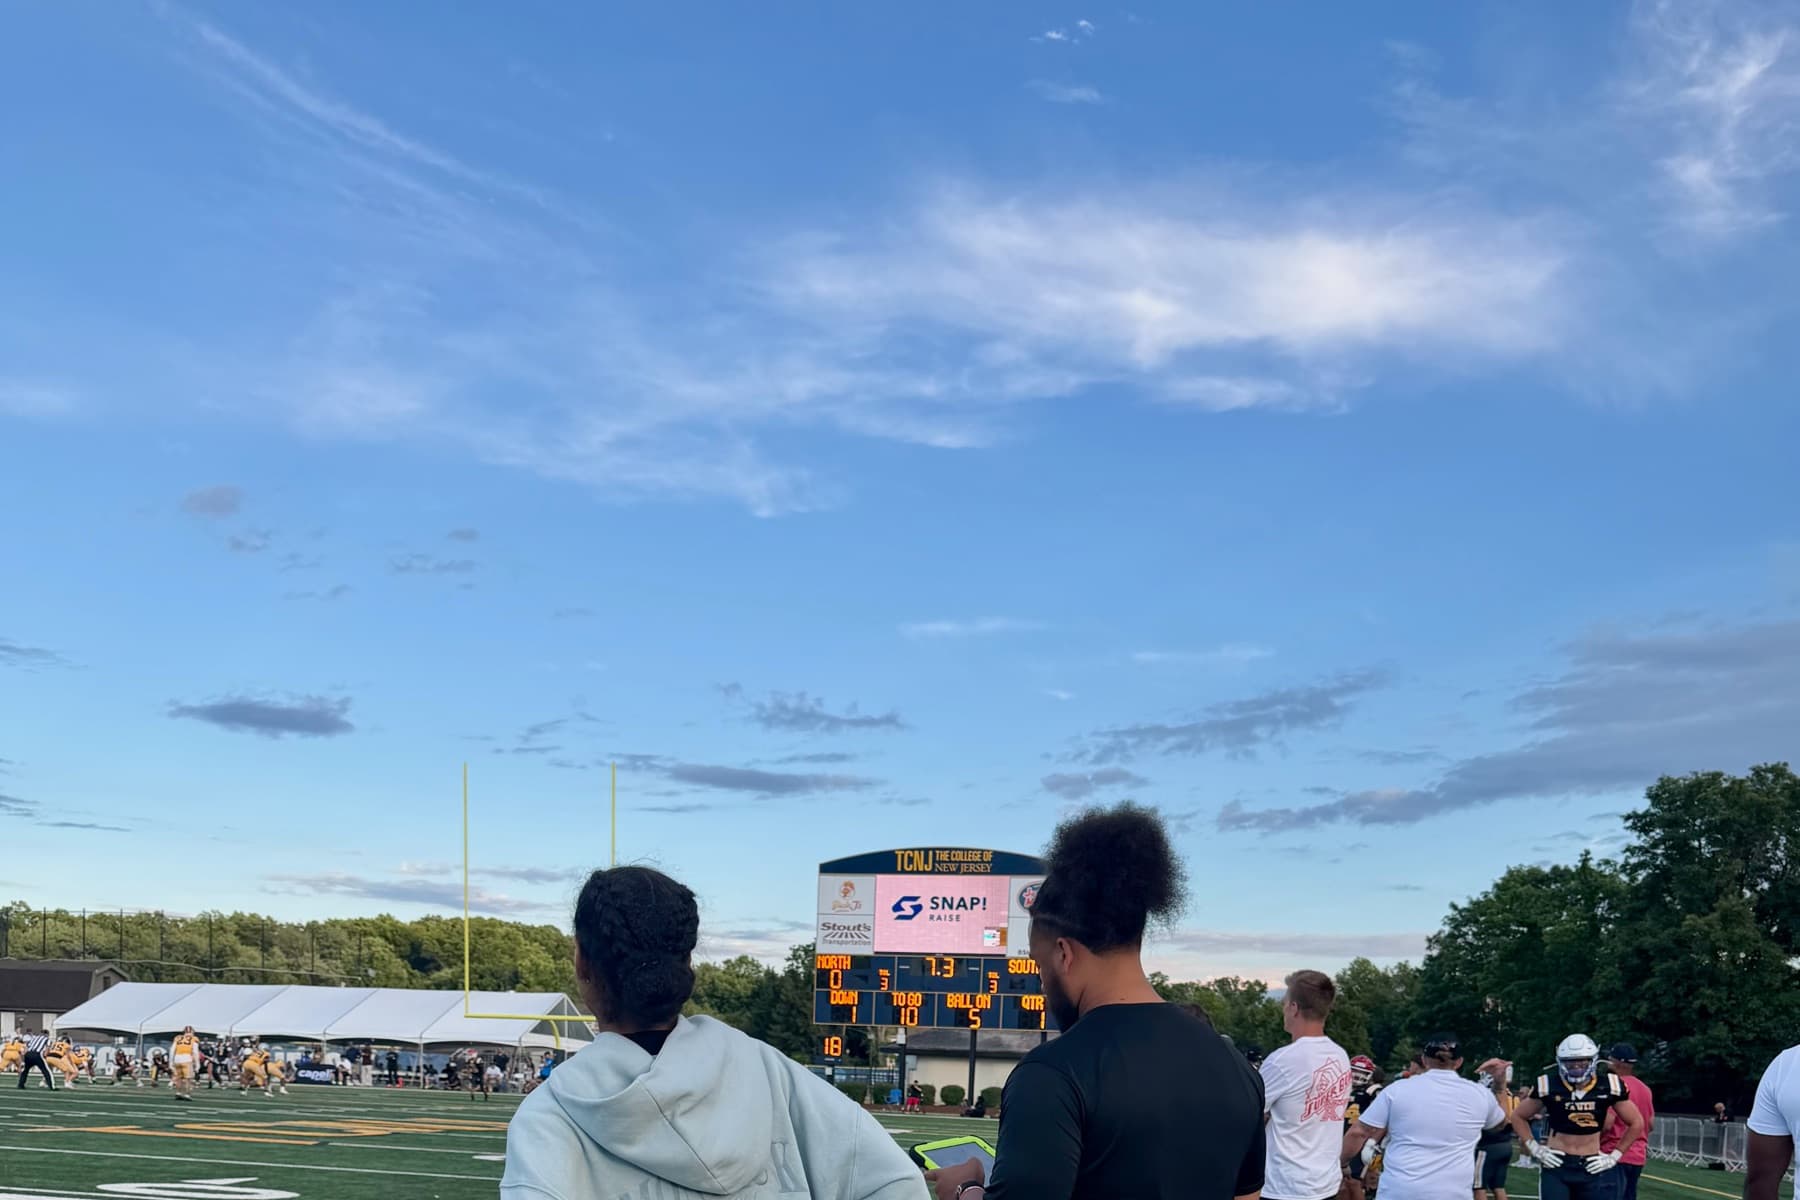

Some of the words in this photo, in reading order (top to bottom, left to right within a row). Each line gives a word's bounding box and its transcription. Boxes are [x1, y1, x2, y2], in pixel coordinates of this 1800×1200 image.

[895, 850, 932, 871] TCNJ
[935, 851, 949, 861] THE
[950, 851, 980, 862] COLLEGE
[983, 851, 993, 862] OF
[935, 862, 959, 872] NEW
[960, 863, 992, 873] JERSEY
[930, 896, 987, 911] SNAP!
[929, 914, 961, 922] RAISE
[820, 922, 872, 932] Stout's
[817, 955, 851, 970] NORTH
[925, 957, 954, 978] 7.3
[830, 969, 842, 990] 0
[880, 977, 889, 991] 3
[989, 980, 998, 994] 3
[830, 990, 858, 1005] DOWN
[892, 992, 906, 1006] TO
[907, 992, 922, 1007] GO
[946, 993, 973, 1008] BALL
[975, 994, 991, 1009] ON
[1021, 995, 1044, 1010] QTR
[851, 1006, 857, 1024] 1
[900, 1006, 918, 1026] 10
[968, 1008, 980, 1029] 5
[1039, 1011, 1046, 1029] 1
[176, 1036, 191, 1046] 23
[824, 1036, 842, 1056] 18
